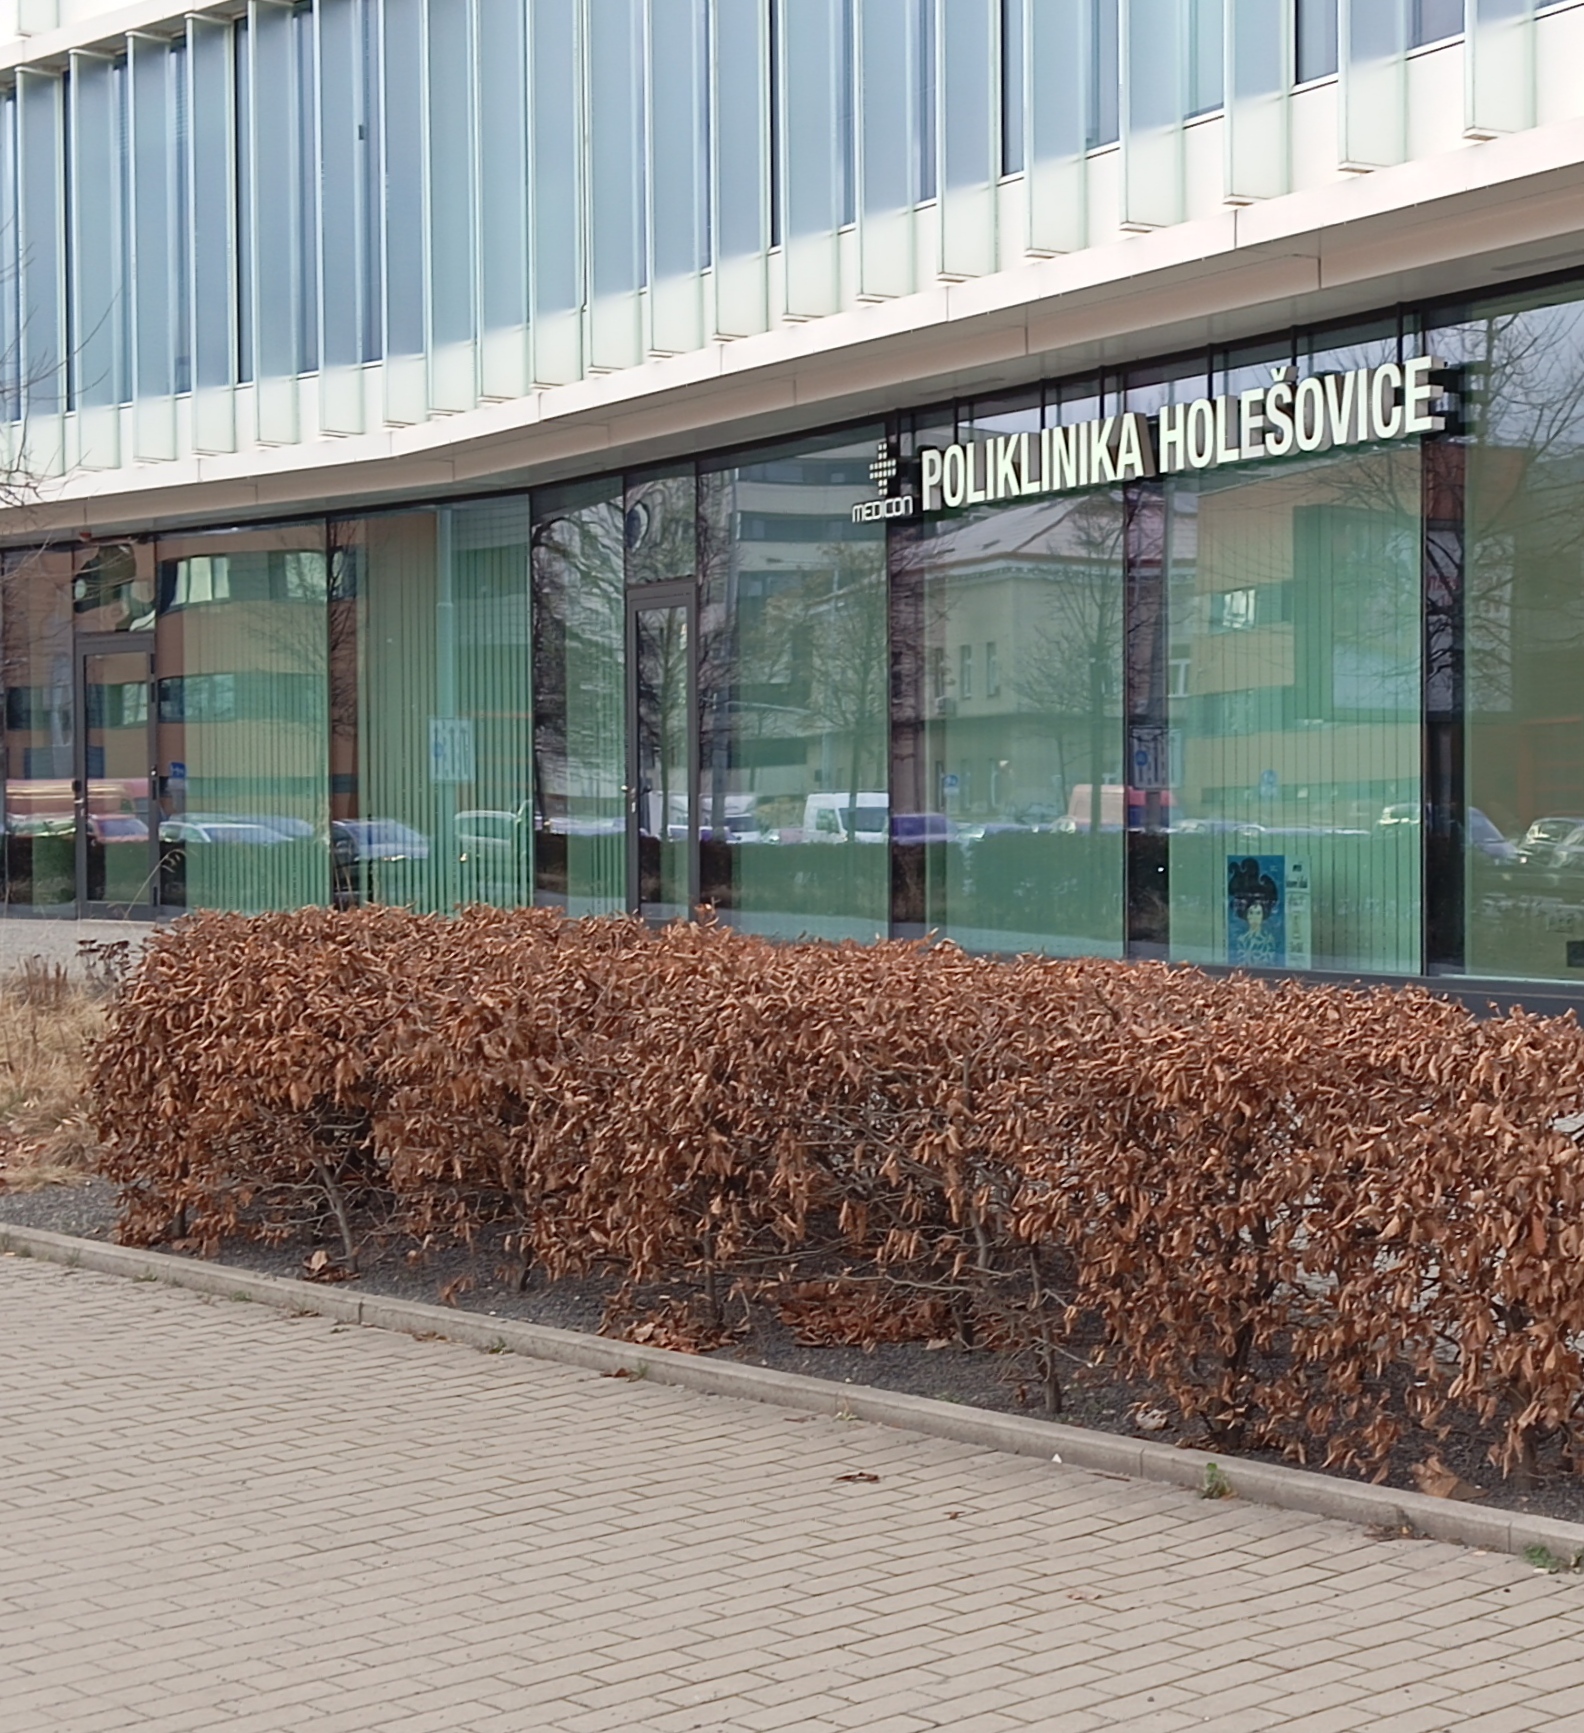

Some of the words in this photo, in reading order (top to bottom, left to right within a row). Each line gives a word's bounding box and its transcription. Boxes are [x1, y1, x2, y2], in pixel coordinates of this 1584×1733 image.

[922, 411, 1145, 512] POLIKLINIKA
[1158, 355, 1436, 474] HOLEŠOVICE
[851, 495, 914, 524] MEDICON
